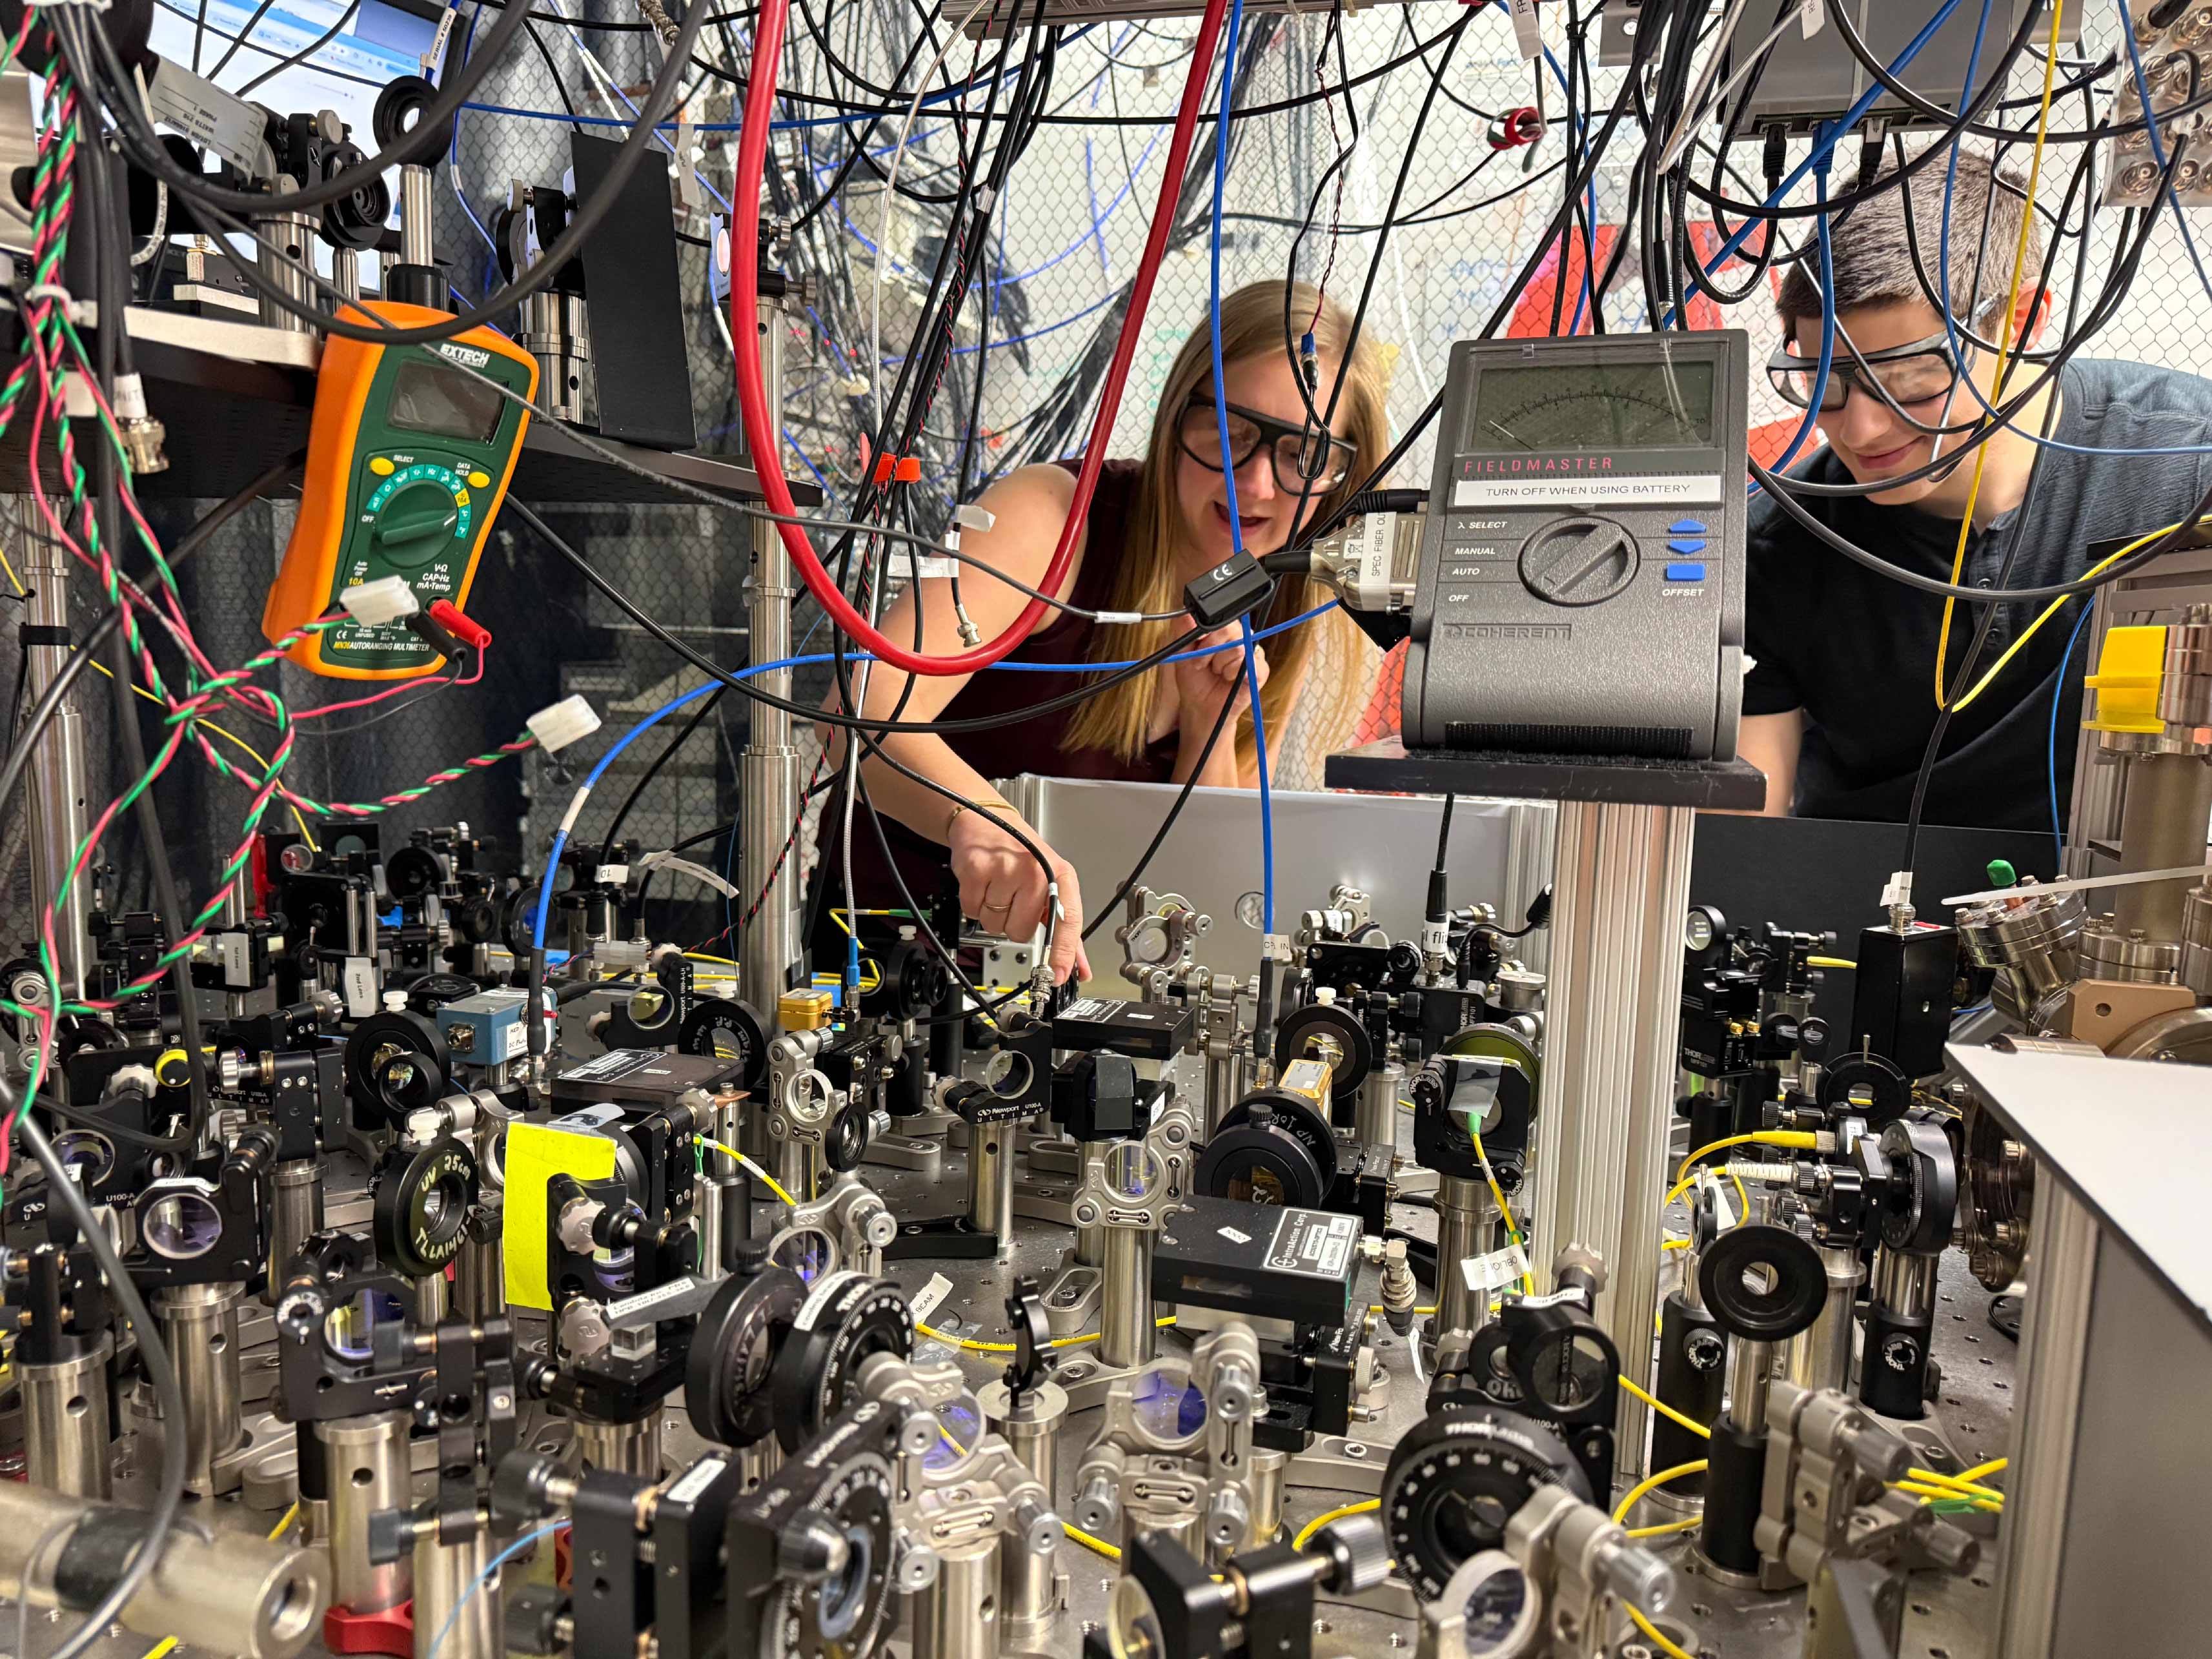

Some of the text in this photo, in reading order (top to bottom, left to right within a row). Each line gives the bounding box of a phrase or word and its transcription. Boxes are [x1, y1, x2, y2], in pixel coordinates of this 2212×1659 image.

[440, 343, 490, 365] EXTECH
[393, 454, 414, 463] SELECT
[1464, 457, 1612, 473] FIELDMASTER
[1487, 483, 1690, 497] TURN OFF WHEN USING BATTERY
[361, 514, 374, 524] OFF
[1372, 512, 1386, 576] SPEC FIBER OU
[1662, 588, 1705, 597] OFFSET
[350, 642, 394, 651] AUTORANGING
[393, 643, 430, 652] MULTIMETER
[1409, 1074, 1439, 1094] THORLABS
[992, 1105, 1019, 1114] Newport
[421, 1166, 437, 1192] UV
[1283, 1227, 1301, 1258] IntraAction
[915, 1293, 935, 1314] BEAM
